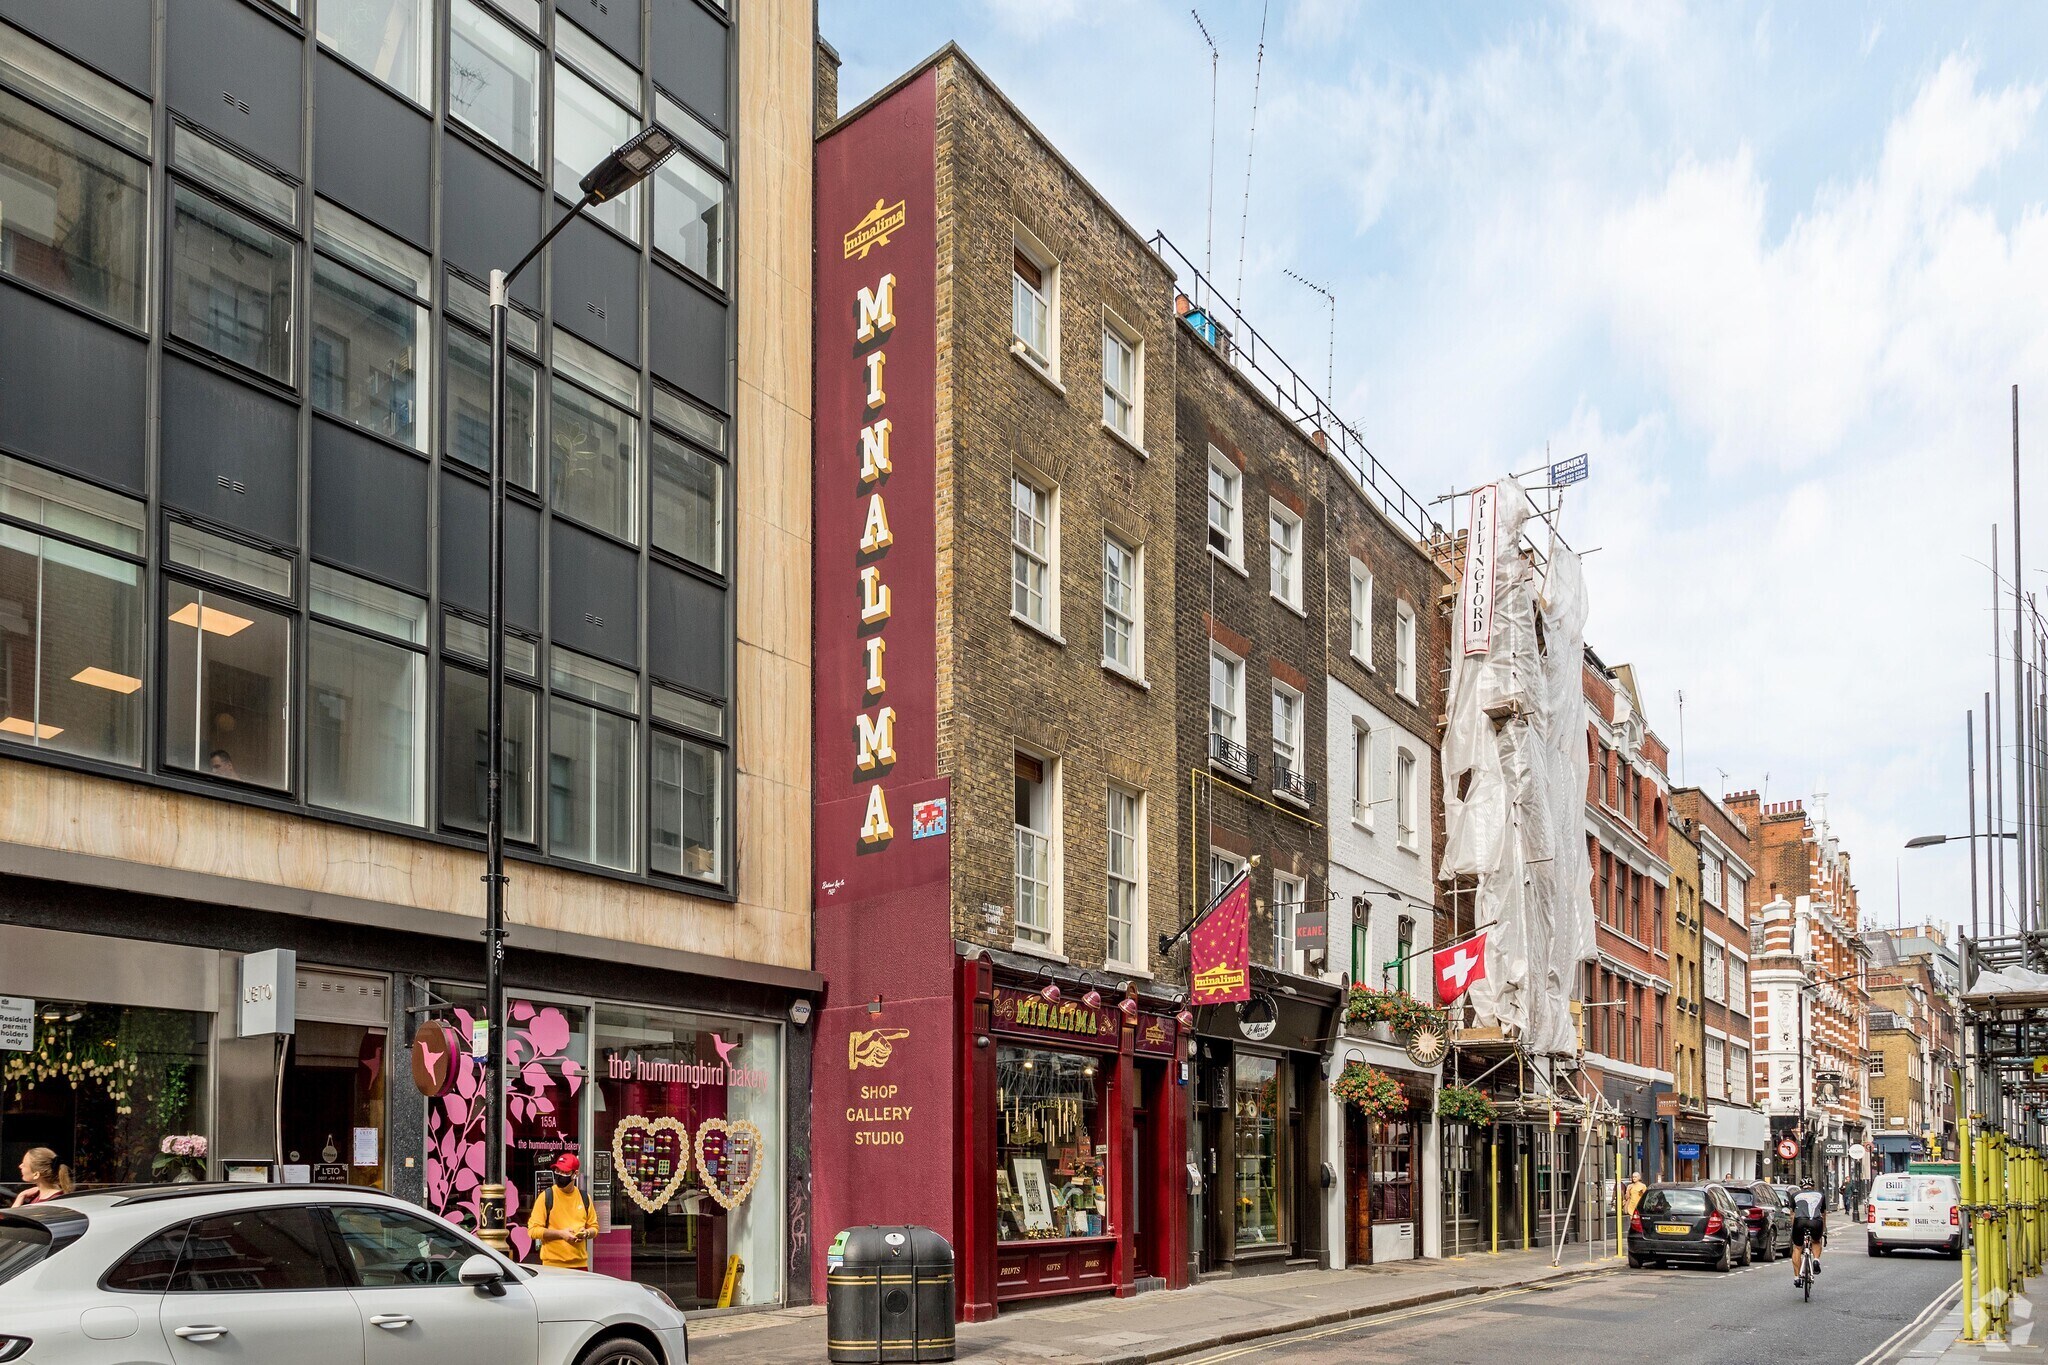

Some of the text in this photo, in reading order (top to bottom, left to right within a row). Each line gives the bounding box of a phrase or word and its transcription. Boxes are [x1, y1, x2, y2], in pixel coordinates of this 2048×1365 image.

[846, 210, 903, 250] minalima
[1555, 455, 1586, 473] HENRY
[1555, 463, 1586, 478] SCAFFOLDING
[855, 273, 897, 845] MINALIMA
[1472, 494, 1487, 633] BILLINGFORD
[1297, 925, 1325, 937] KEANE.
[1196, 974, 1242, 986] minalima
[0, 1015, 31, 1023] Resident
[1016, 999, 1097, 1035] MINALIMA
[608, 1052, 769, 1093] the hummingbird bakery
[861, 1085, 897, 1099] SHOP
[846, 1106, 913, 1121] GALLERY
[541, 1116, 556, 1128] 155A
[855, 1131, 904, 1145] STUDIO
[518, 1139, 581, 1152] the hummingbird bakery
[1001, 1267, 1020, 1275] PRINTS
[1046, 1263, 1060, 1271] GIFTS
[1085, 1260, 1099, 1268] BOOKS
